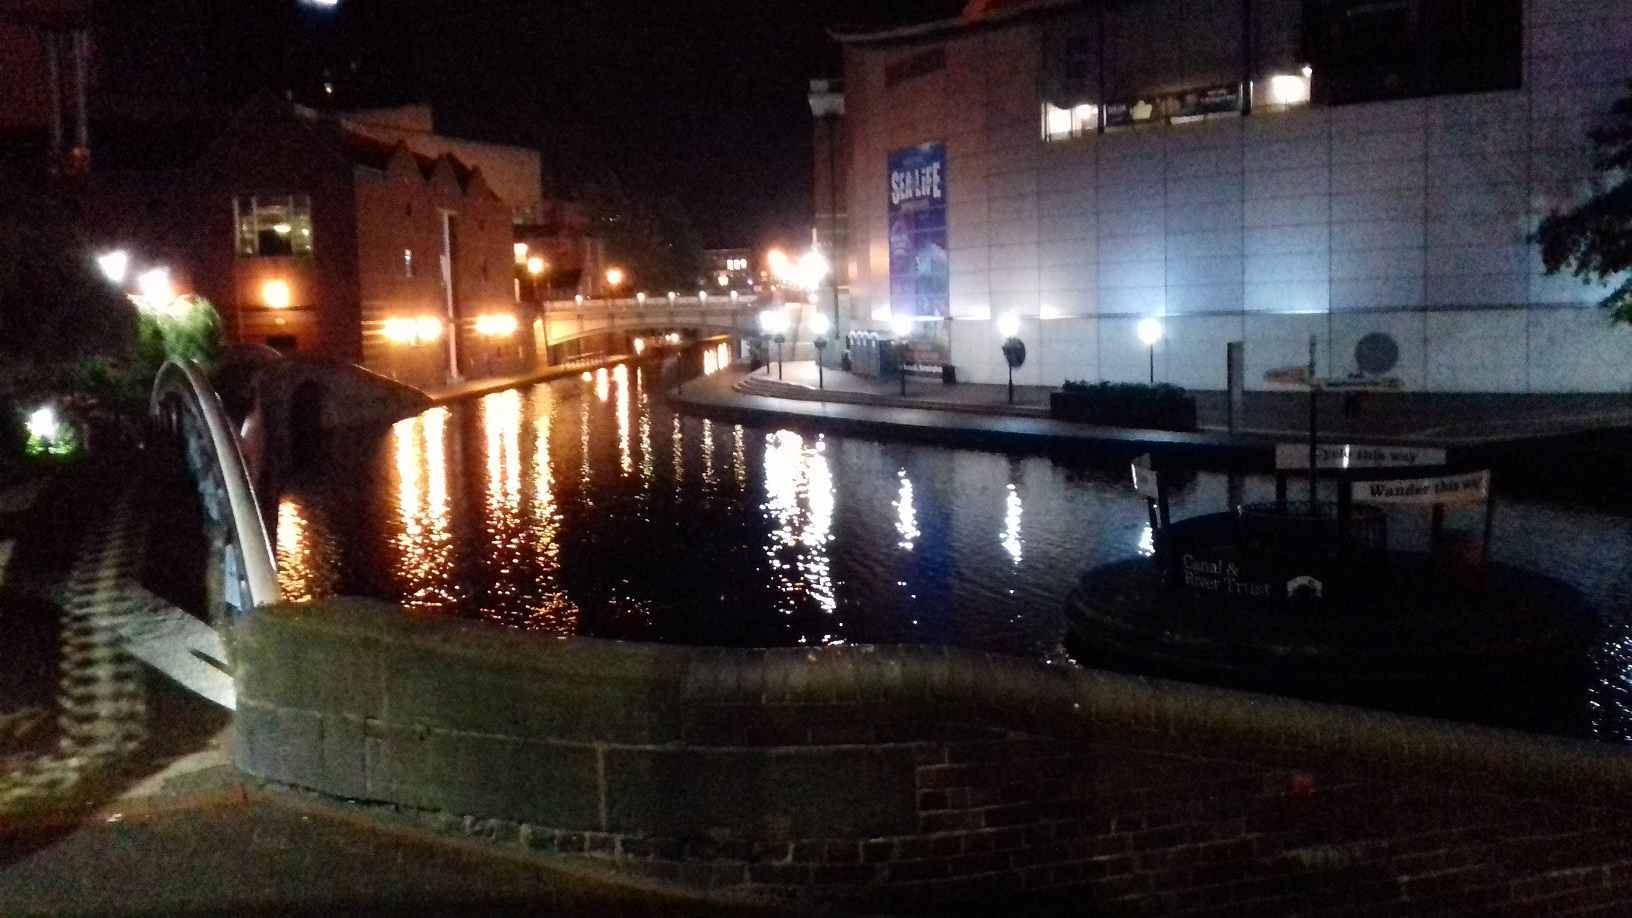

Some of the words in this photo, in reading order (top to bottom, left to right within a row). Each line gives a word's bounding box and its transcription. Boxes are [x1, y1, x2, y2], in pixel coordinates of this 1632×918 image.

[891, 172, 913, 205] SEA
[1370, 482, 1428, 497] Wander
[1184, 553, 1222, 574] Canal
[1225, 562, 1240, 578] &
[1185, 572, 1219, 590] River
[1225, 577, 1272, 595] Trust
